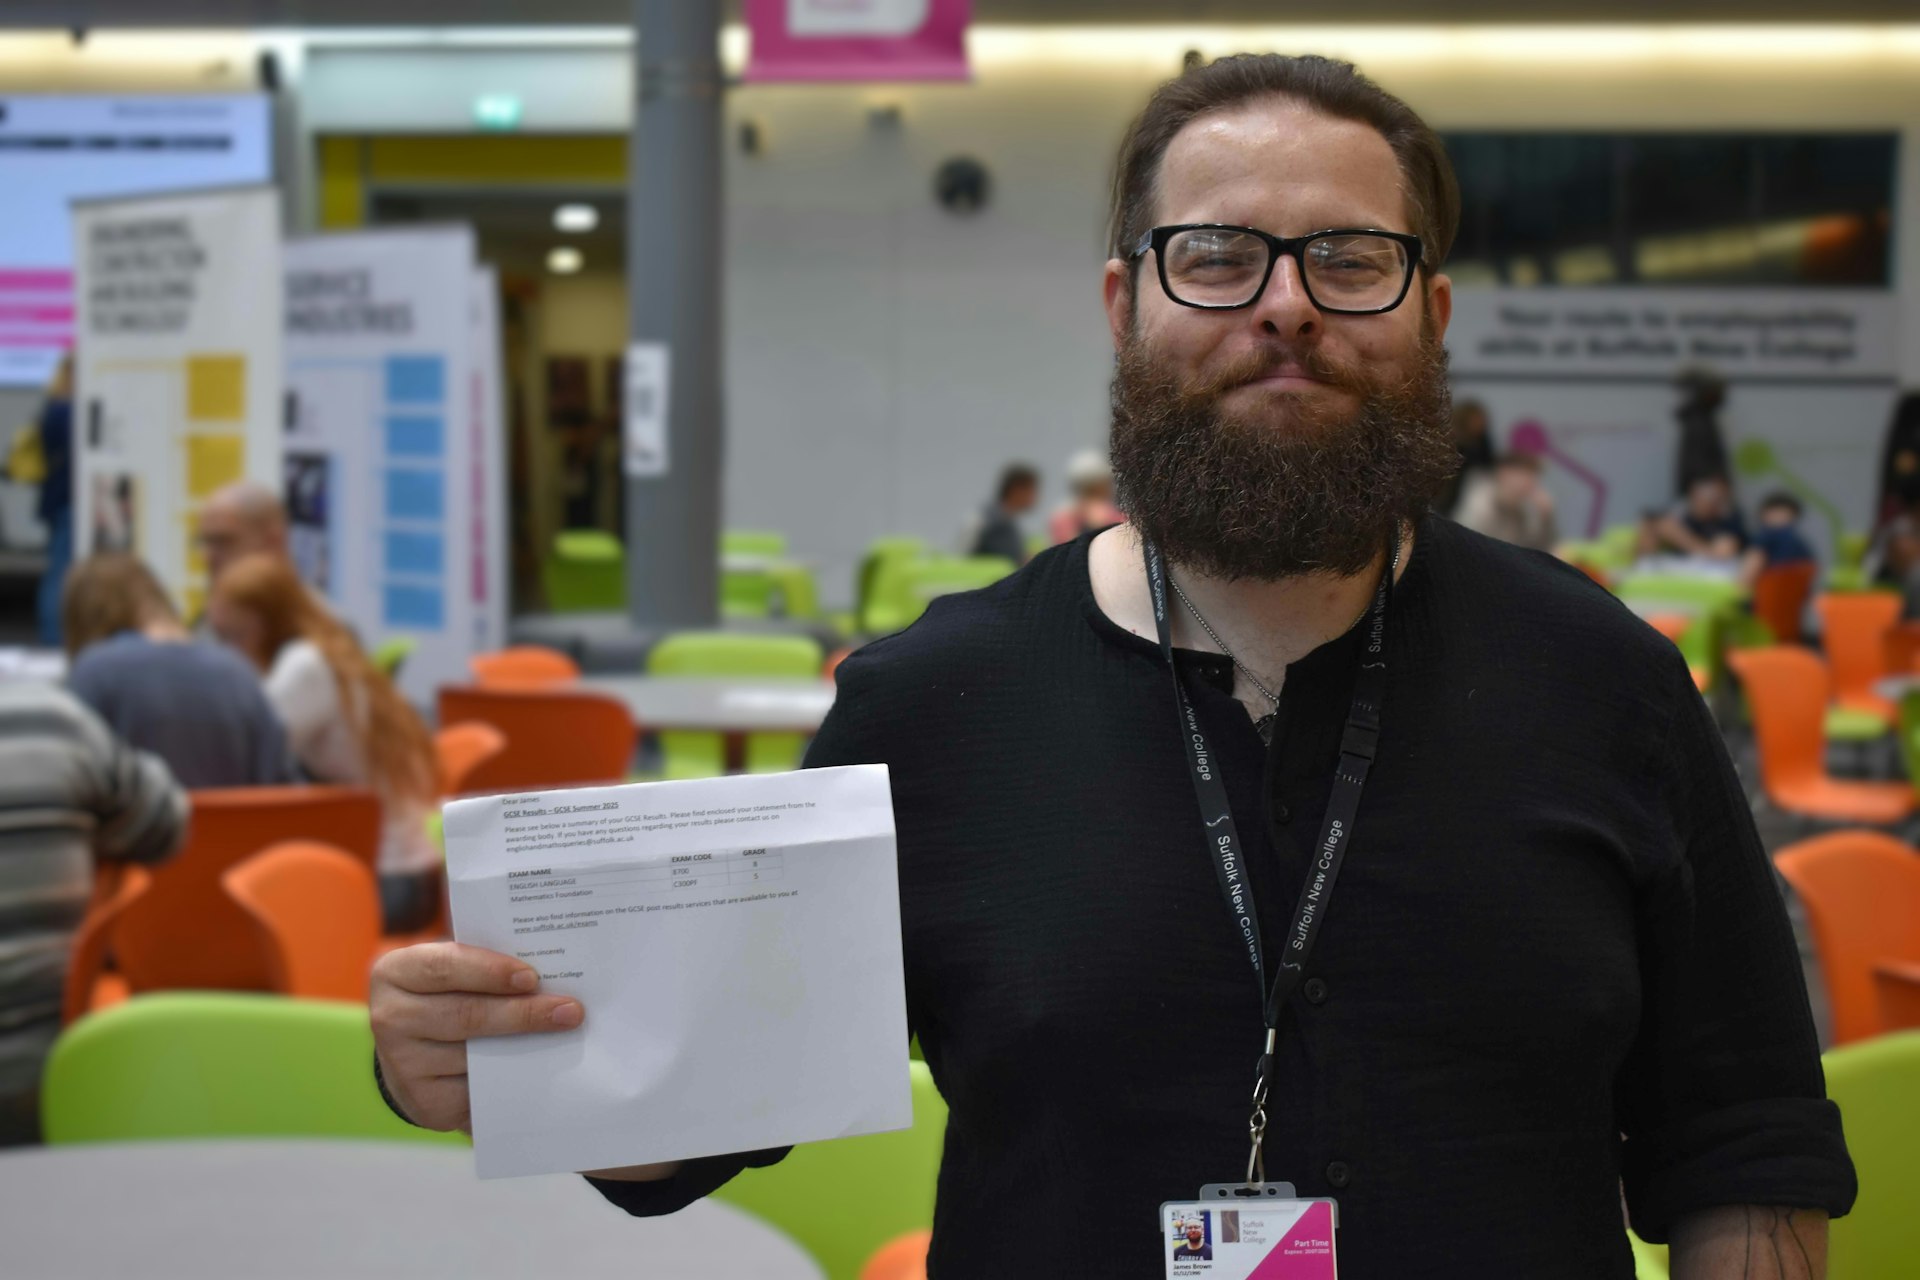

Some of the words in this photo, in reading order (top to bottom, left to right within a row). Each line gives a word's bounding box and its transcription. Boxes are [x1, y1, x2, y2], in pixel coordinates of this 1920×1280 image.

[1500, 306, 1552, 327] Your
[1566, 310, 1632, 328] route
[1642, 309, 1668, 328] to
[1677, 307, 1857, 336] employability
[1478, 337, 1542, 357] skills
[1553, 338, 1577, 357] at
[1587, 336, 1678, 358] Suffolk
[1690, 338, 1747, 359] New
[1758, 338, 1857, 365] College
[1154, 579, 1164, 622] College
[1368, 616, 1384, 653] Suffolk
[1186, 706, 1199, 731] New
[1192, 733, 1212, 781] College
[504, 810, 520, 818] GCSE
[522, 809, 547, 817] Results
[554, 806, 571, 815] GCSE
[573, 804, 601, 812] Summer
[603, 802, 619, 810] 2025
[505, 825, 526, 833] Please
[540, 823, 560, 831] below
[568, 819, 598, 828] summary
[608, 817, 623, 825] your
[707, 807, 736, 815] enclosed
[737, 806, 752, 814] your
[753, 803, 787, 812] statement
[506, 834, 536, 843] awarding
[563, 831, 576, 839] you
[608, 825, 640, 834] questions
[641, 821, 673, 831] regarding
[674, 821, 689, 829] your
[691, 818, 713, 827] results
[714, 816, 734, 825] please
[736, 814, 760, 822] contact
[508, 870, 529, 878] EXAM
[530, 868, 552, 877] NAME
[671, 855, 692, 863] EXAM
[693, 853, 712, 861] CODE
[742, 848, 767, 857] GRADE
[509, 881, 538, 890] ENGLISH
[539, 877, 577, 887] LANGUAGE
[510, 893, 554, 902] Mathematics
[555, 889, 593, 898] Foundation
[1292, 902, 1317, 951] Suffolk
[1307, 871, 1327, 902] New
[1317, 819, 1343, 871] College
[513, 916, 534, 924] Please
[536, 914, 549, 922] also
[550, 913, 563, 921] find
[565, 910, 604, 919] information
[628, 905, 644, 913] GCSE
[646, 904, 661, 913] post
[662, 902, 684, 910] results
[685, 900, 711, 909] services
[712, 898, 726, 906] that
[740, 892, 768, 903] available
[778, 891, 790, 899] you
[1217, 834, 1239, 883] Suffolk
[1230, 882, 1246, 914] New
[1239, 916, 1260, 972] College
[536, 947, 565, 957] sincerely
[559, 970, 584, 979] College
[1242, 1220, 1265, 1228] Suffolk
[1243, 1236, 1267, 1244] College
[1294, 1239, 1310, 1247] Part
[1311, 1239, 1329, 1247] Time
